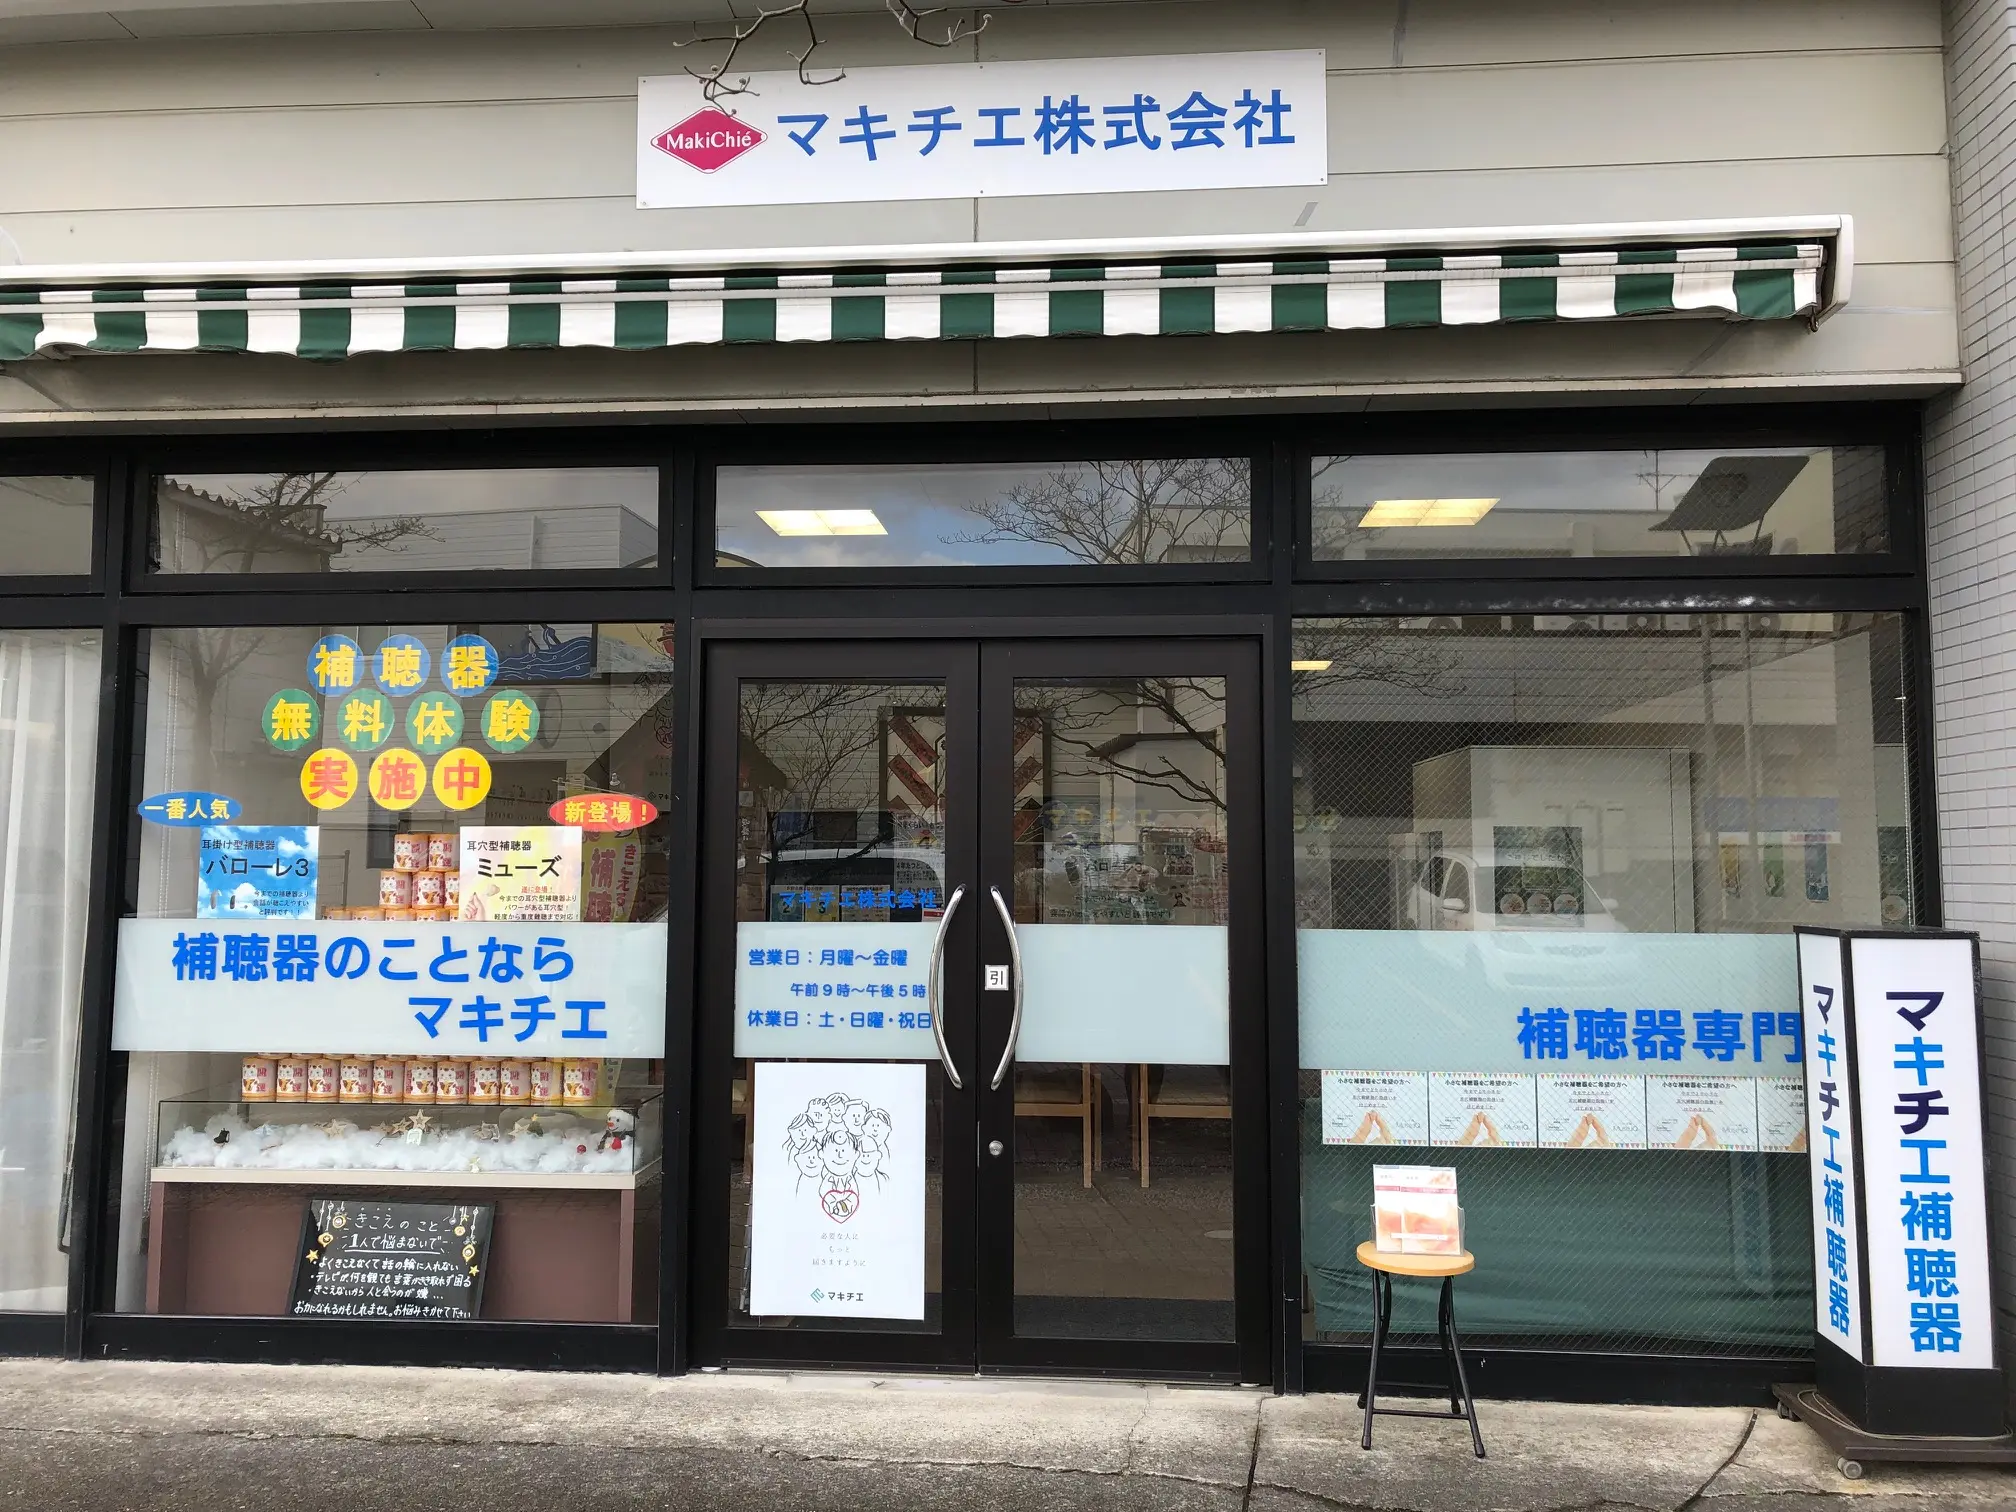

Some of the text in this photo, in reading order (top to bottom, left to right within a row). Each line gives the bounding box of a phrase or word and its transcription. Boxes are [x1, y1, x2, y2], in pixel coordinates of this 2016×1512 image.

[665, 130, 752, 150] MakiChié
[777, 88, 1296, 162] マキチエ株式会社
[313, 645, 491, 689] 補聴器
[270, 699, 532, 743] 無料体験
[308, 758, 480, 801] 実施中
[144, 798, 231, 820] 一番人気
[201, 840, 276, 851] 耳掛け型補聴器
[466, 840, 532, 852] 耳穴型補聴器
[205, 854, 309, 877] バローレ3
[477, 854, 563, 878] ミューズ
[779, 889, 938, 909] マキチエ株式会社
[171, 931, 575, 984] 補聴器のことなら
[989, 969, 1005, 987] 引
[407, 994, 608, 1043] マキチエ
[1516, 1006, 1803, 1064] 補聴器専門
[1811, 984, 1850, 1338] マキチエ補聴器
[1885, 990, 1963, 1354] マキチエ補聴器
[827, 1291, 864, 1302] マキチエ
